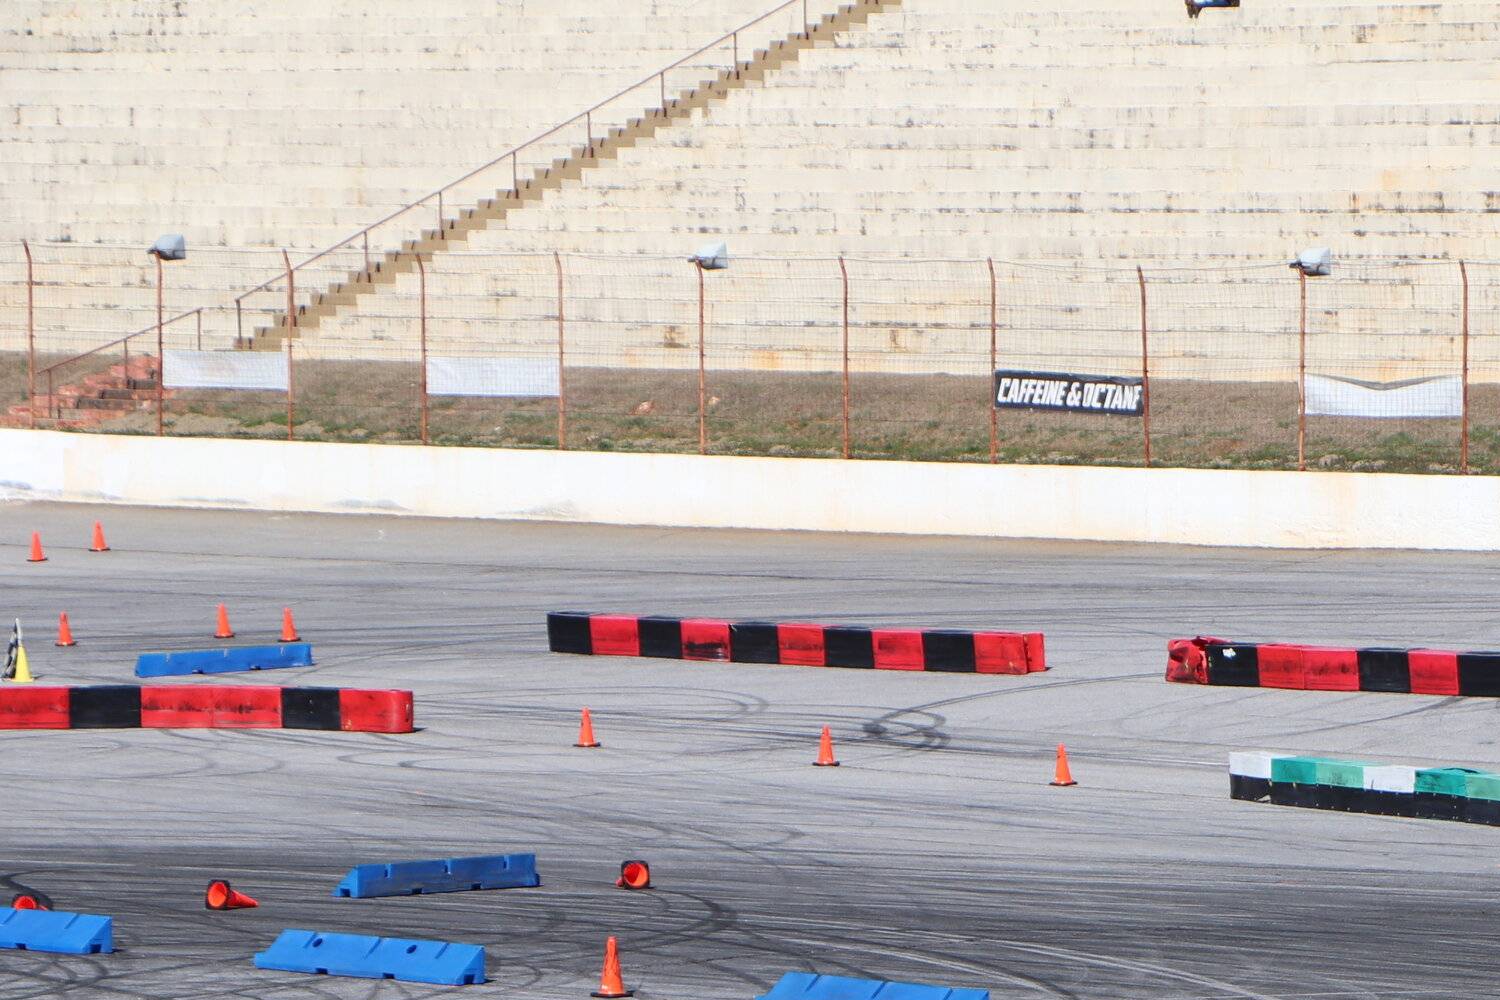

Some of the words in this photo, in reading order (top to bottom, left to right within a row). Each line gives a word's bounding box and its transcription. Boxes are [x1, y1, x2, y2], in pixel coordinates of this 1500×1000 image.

[997, 377, 1068, 406] CAFFEINE
[1066, 381, 1082, 407] &
[1082, 382, 1142, 410] OCTANE
